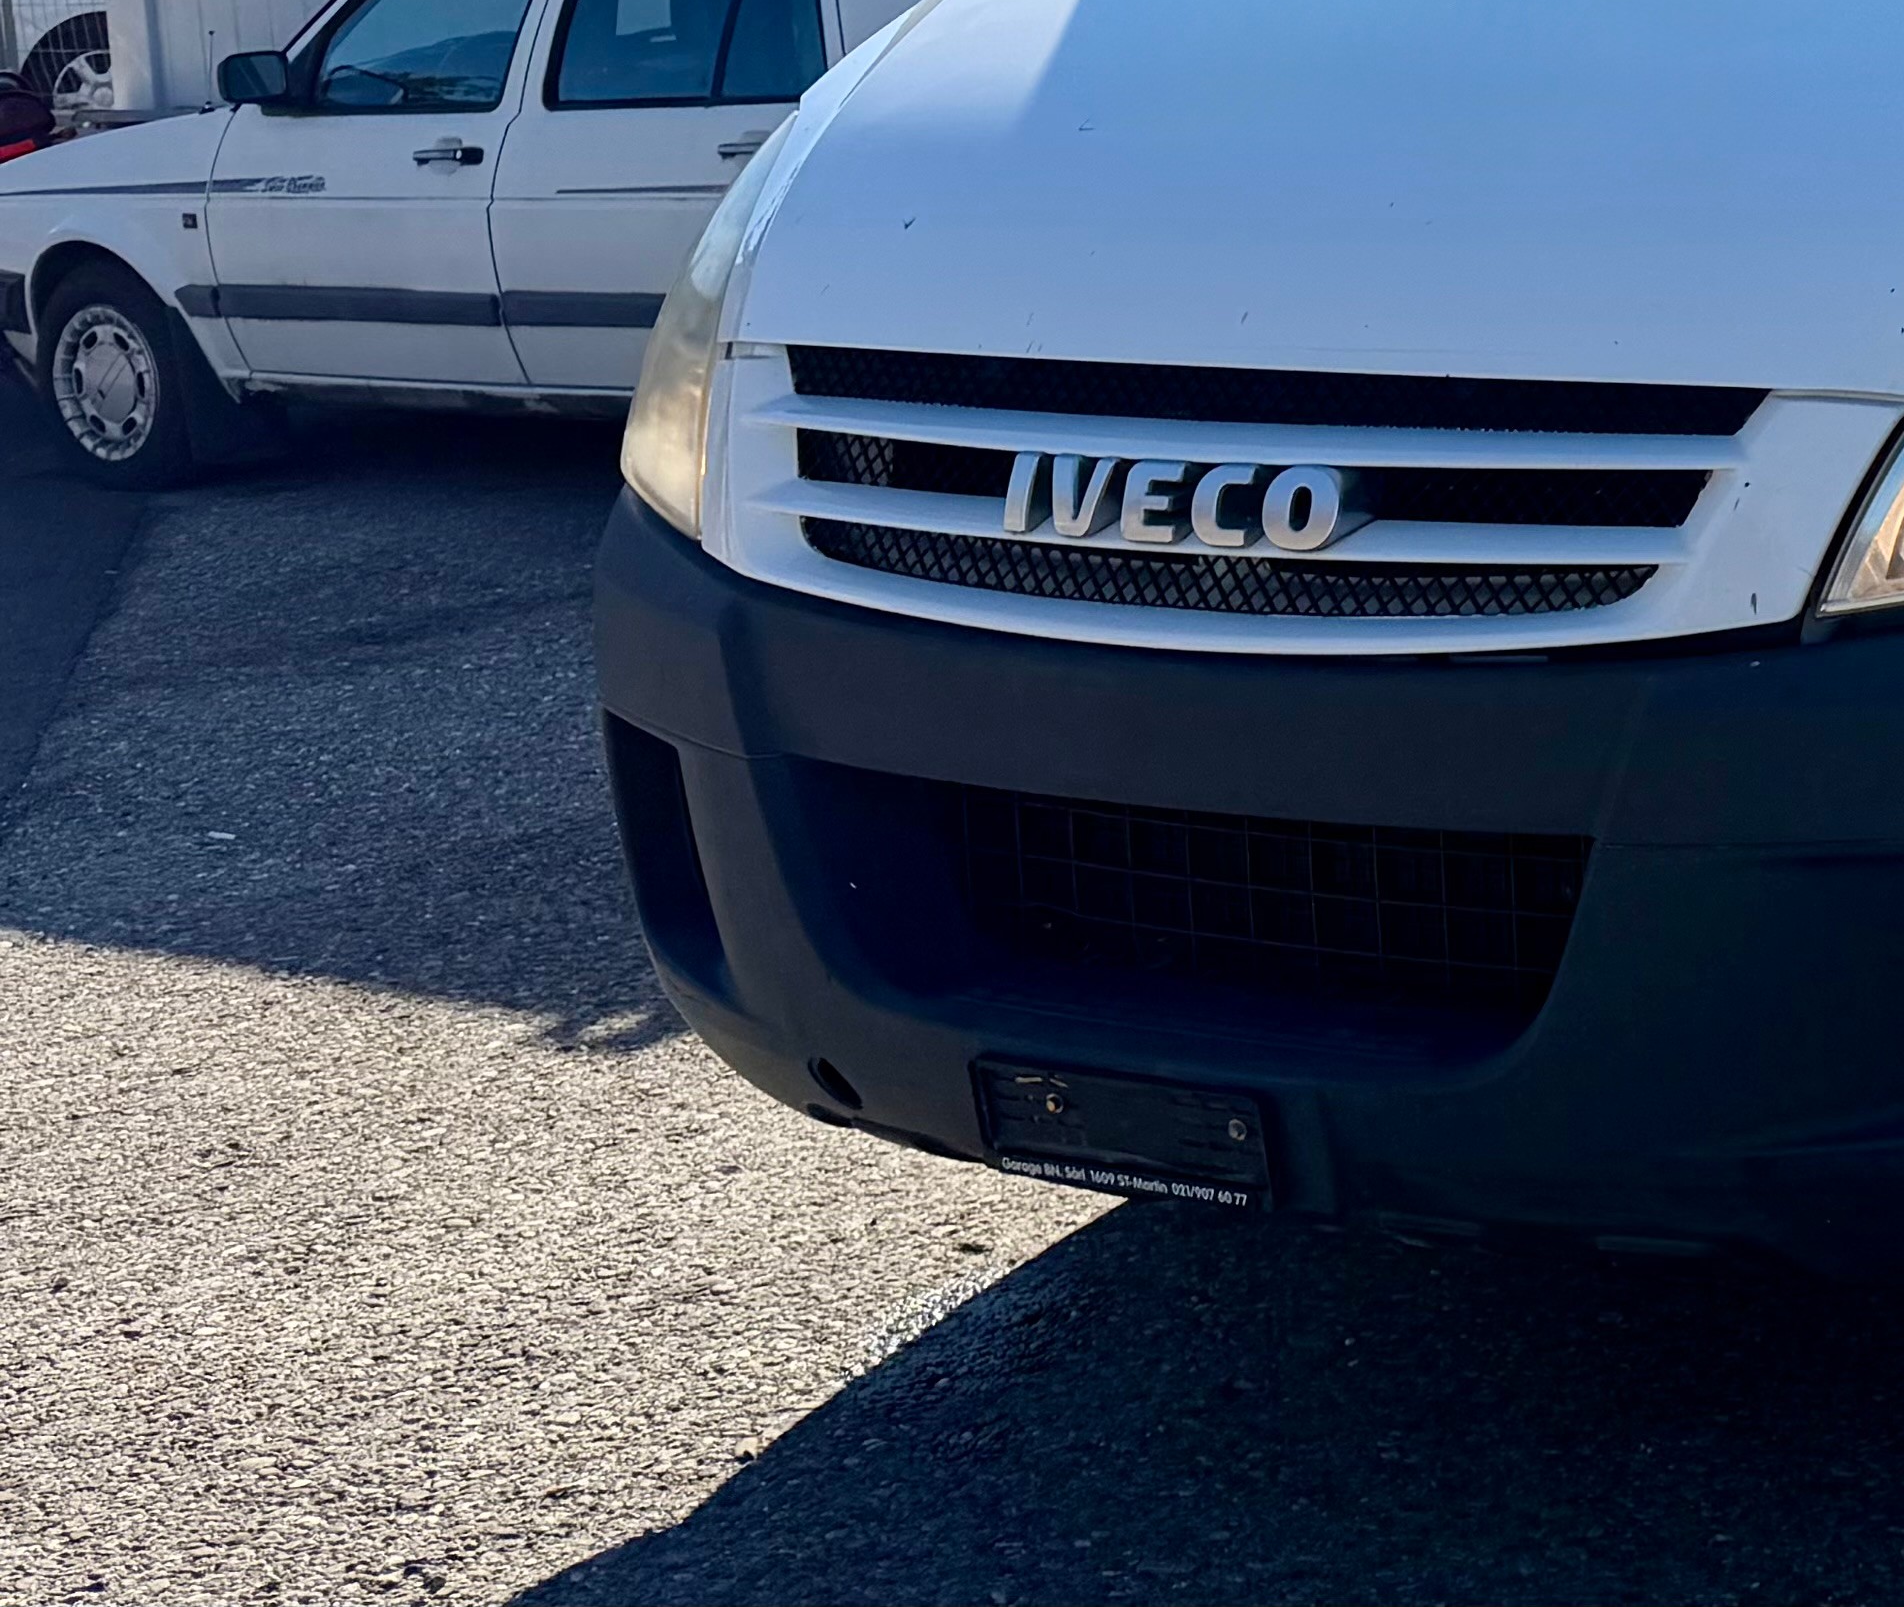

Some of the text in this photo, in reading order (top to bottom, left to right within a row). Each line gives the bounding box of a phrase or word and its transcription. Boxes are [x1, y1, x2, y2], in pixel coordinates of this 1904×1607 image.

[1003, 450, 1349, 552] IVECO
[1001, 1156, 1043, 1177] Garage
[1089, 1169, 1115, 1186] 1609
[1171, 1182, 1215, 1201] 021/907
[1217, 1190, 1233, 1204] 60
[1233, 1192, 1248, 1207] 77
